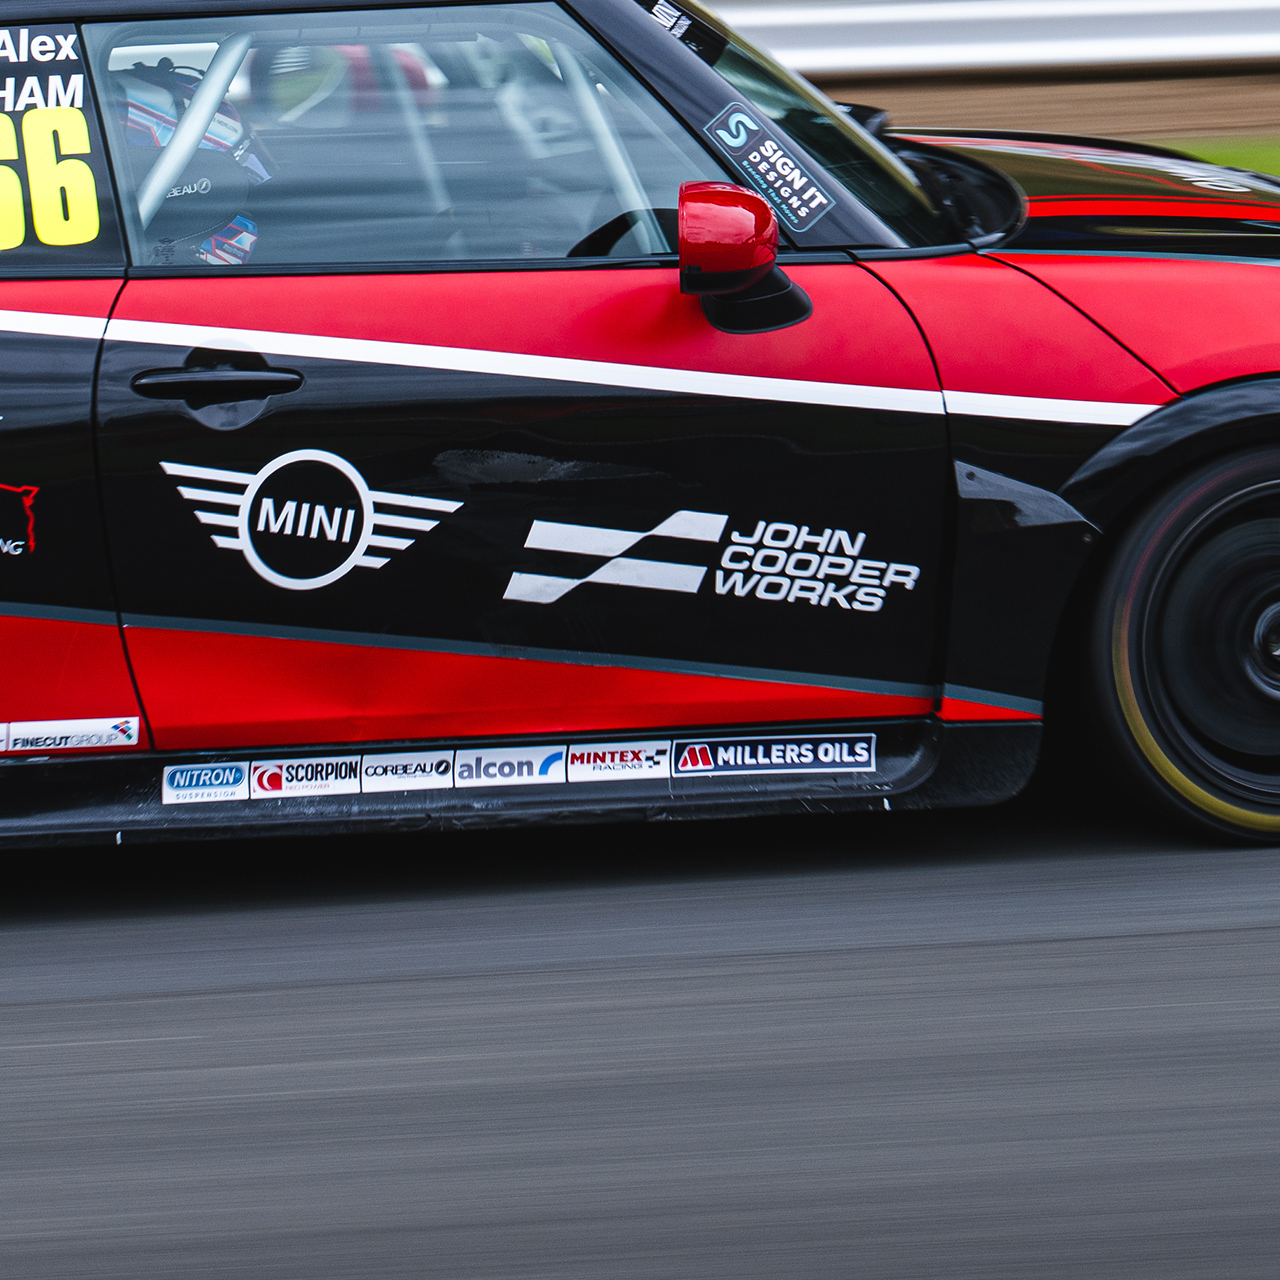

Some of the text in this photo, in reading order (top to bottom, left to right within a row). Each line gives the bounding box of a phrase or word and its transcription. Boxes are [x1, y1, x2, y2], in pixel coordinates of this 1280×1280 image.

[748, 151, 810, 217] DESIGNS
[759, 140, 828, 209] SIGN IT
[256, 497, 356, 543] MINI
[730, 520, 867, 557] JOHN
[720, 544, 921, 591] COOPER
[715, 569, 887, 612] WORKS
[570, 750, 643, 765] MINTEX
[717, 742, 870, 766] MILLERS OILS
[172, 768, 236, 788] NITRON
[285, 761, 359, 783] SCORPION
[365, 762, 434, 777] CORBEAU
[458, 756, 534, 780] alcon
[593, 763, 644, 772] RACING
[175, 791, 237, 800] SUSPENSION
